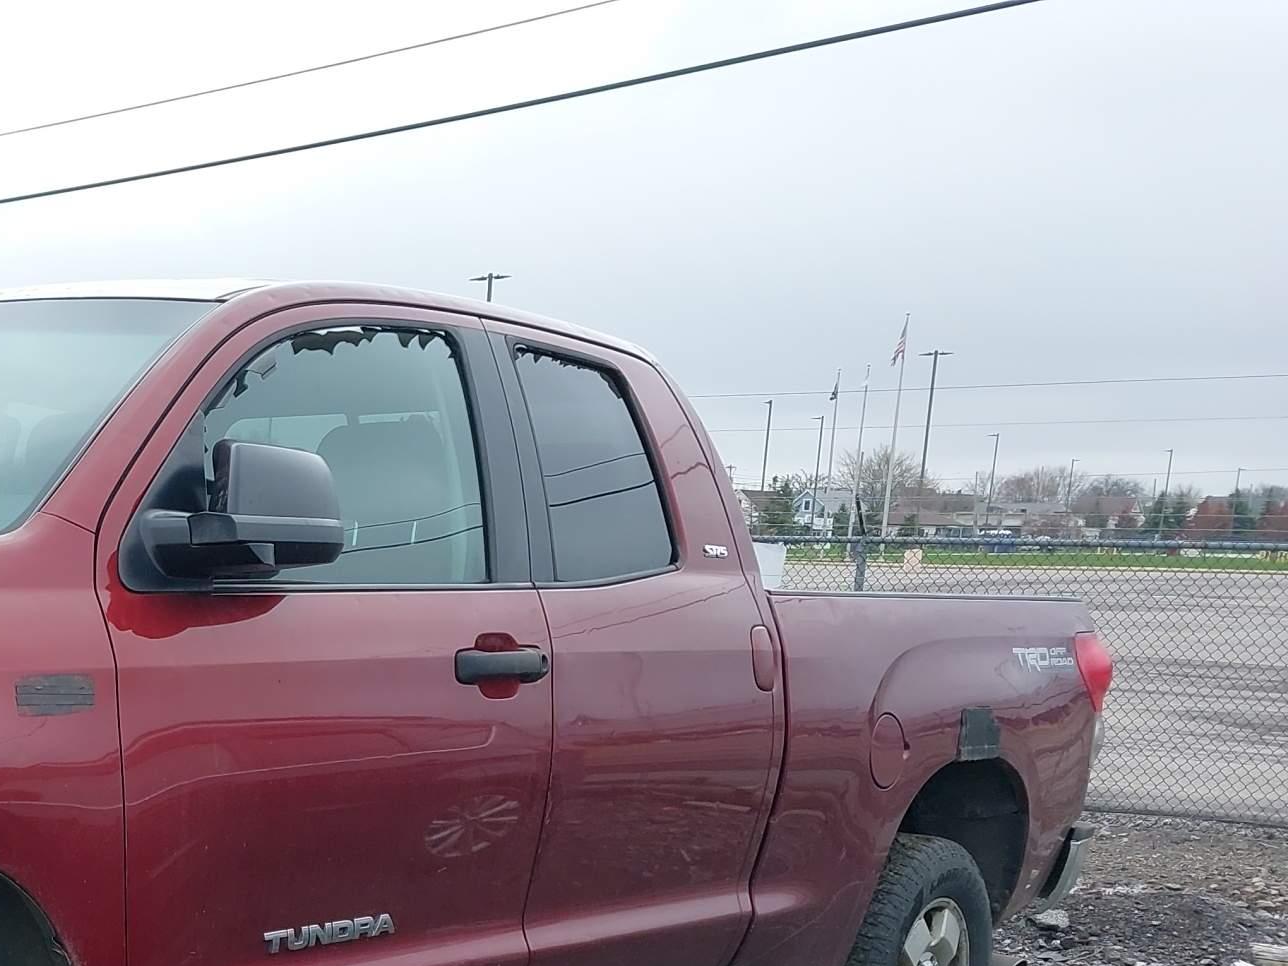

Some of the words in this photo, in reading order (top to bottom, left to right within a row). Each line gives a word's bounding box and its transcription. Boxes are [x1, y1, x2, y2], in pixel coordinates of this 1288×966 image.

[1013, 647, 1049, 672] TRD
[1050, 657, 1073, 666] ROAD
[264, 913, 395, 953] TUNDRA
